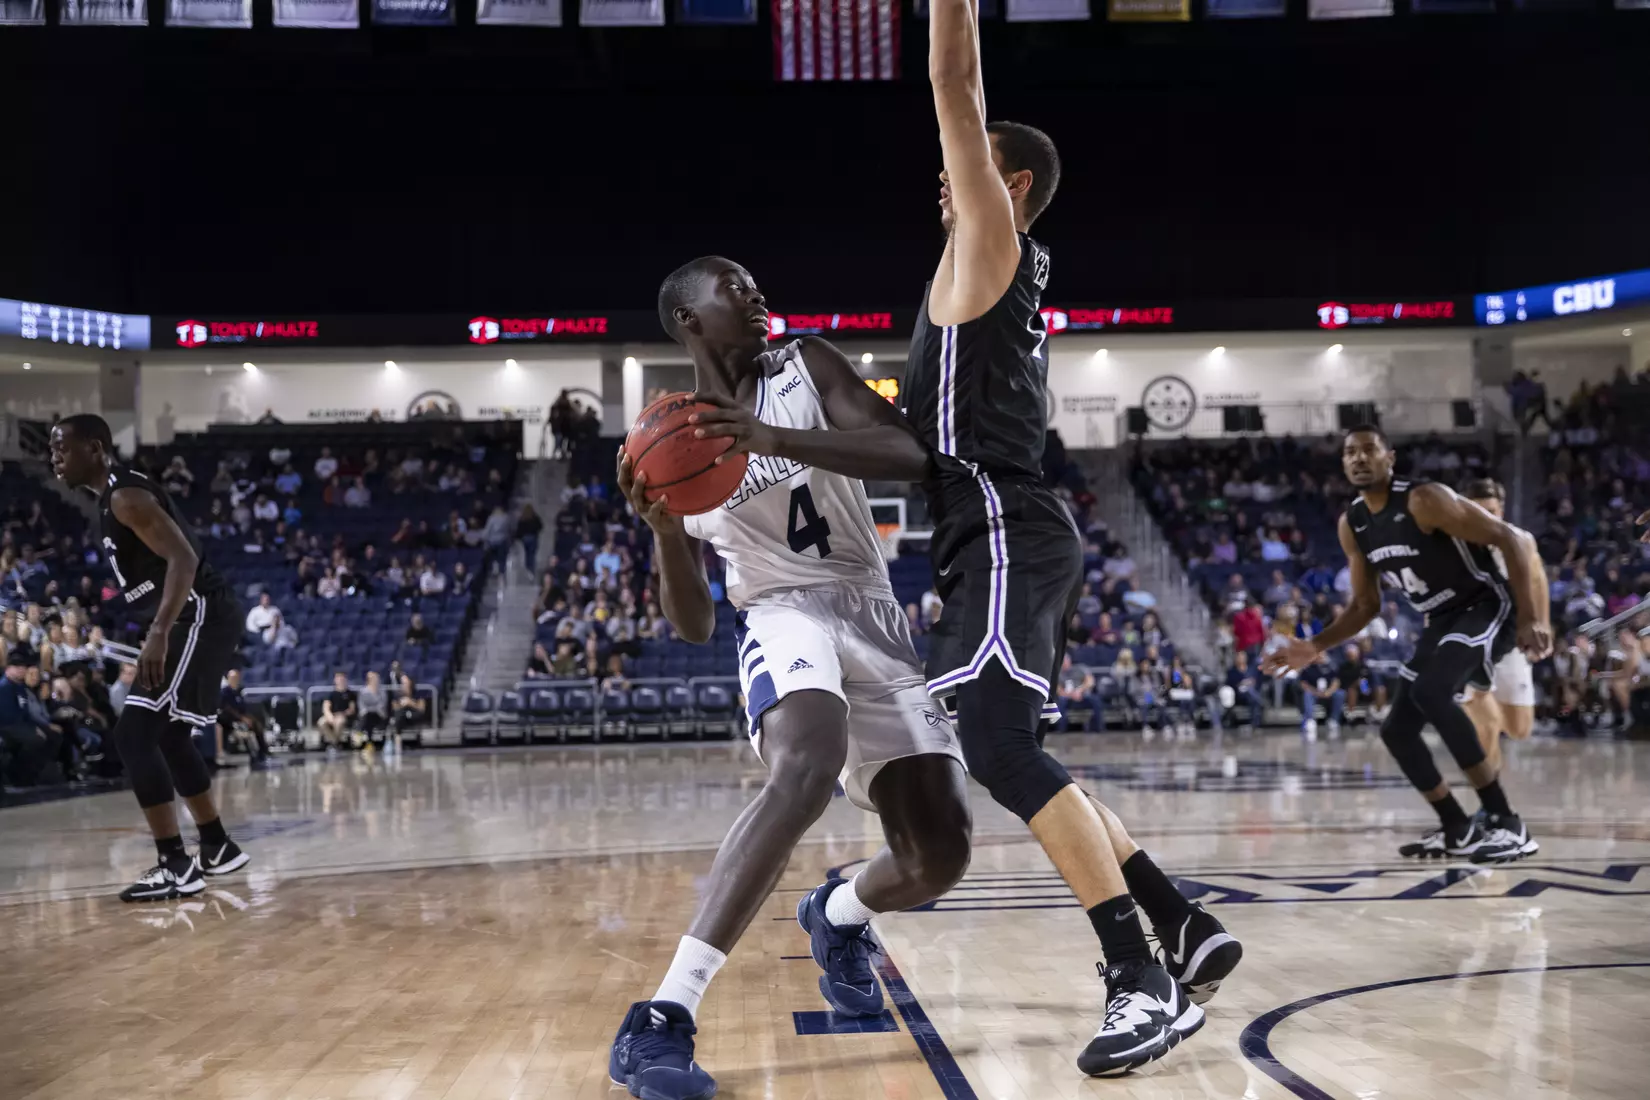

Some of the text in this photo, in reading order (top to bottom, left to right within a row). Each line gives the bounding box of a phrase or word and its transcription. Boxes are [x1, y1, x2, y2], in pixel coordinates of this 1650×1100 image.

[1552, 278, 1616, 316] CBU
[778, 375, 802, 397] WAC
[787, 482, 832, 559] 4
